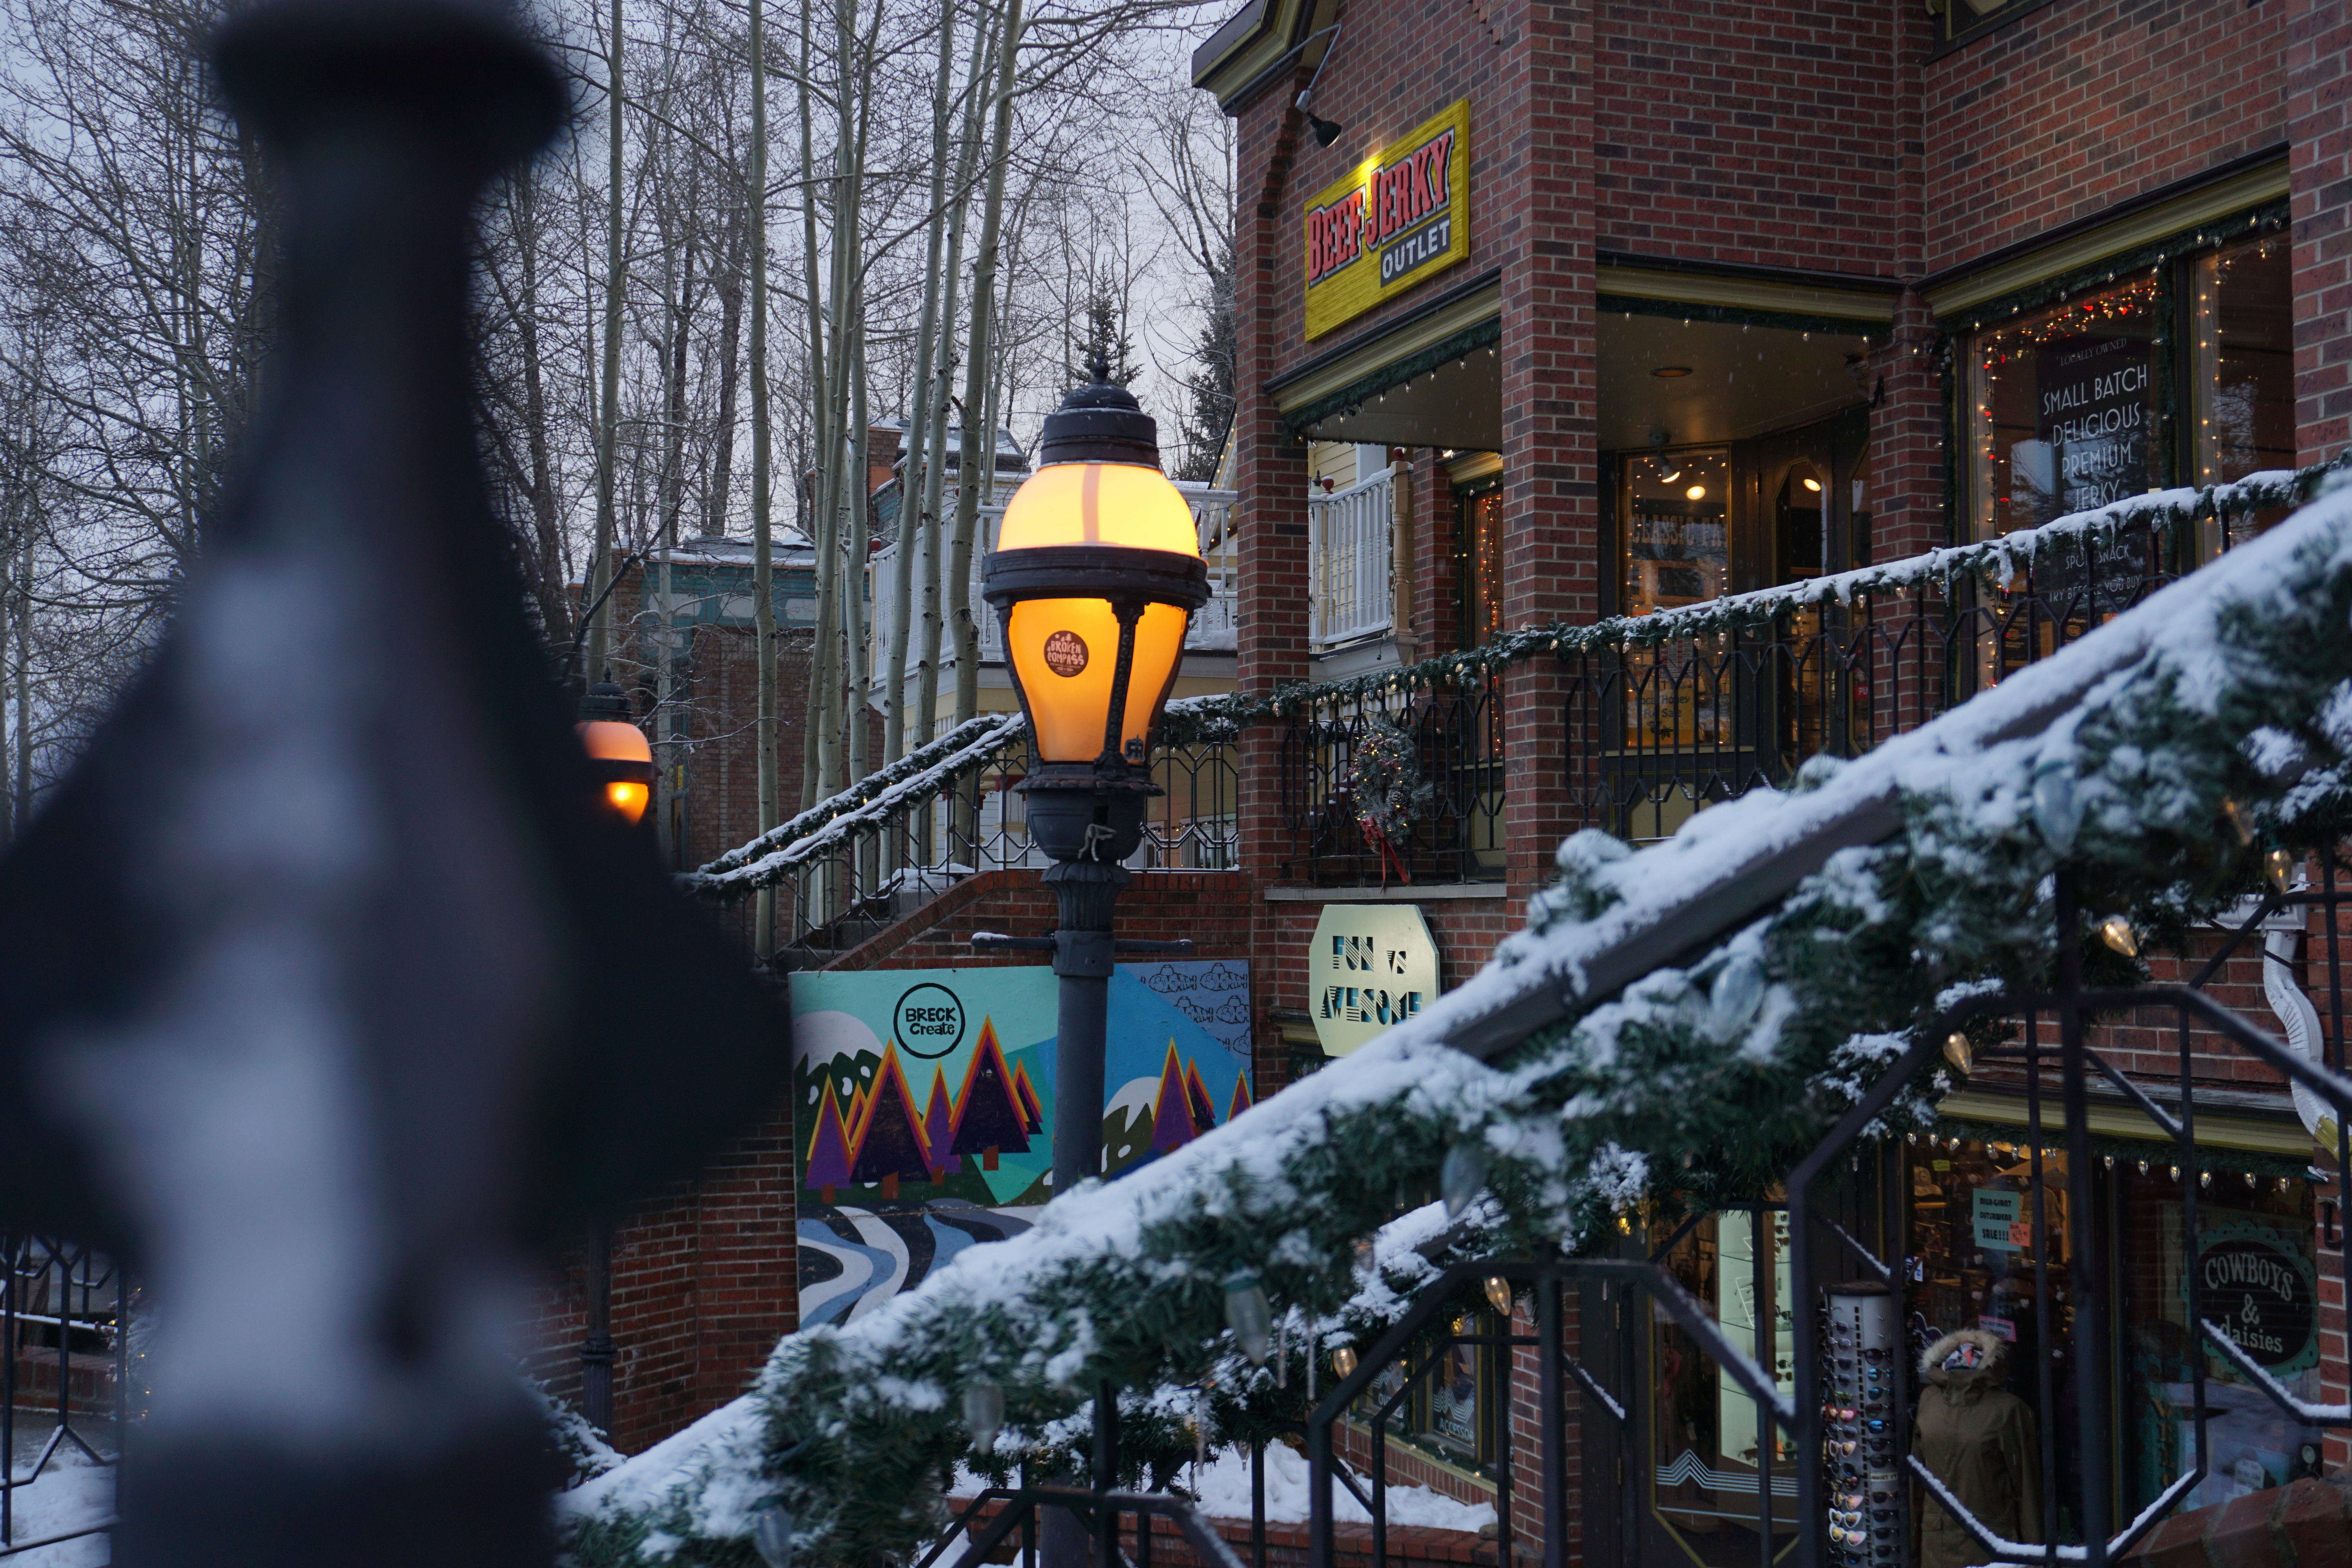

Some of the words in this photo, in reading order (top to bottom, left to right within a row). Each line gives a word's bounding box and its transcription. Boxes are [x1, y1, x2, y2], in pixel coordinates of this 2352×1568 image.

[1308, 188, 1366, 284] BEEF
[1365, 132, 1454, 247] JERKY
[1382, 219, 1450, 279] OUTLET
[2060, 347, 2093, 366] LOCALLY
[2096, 338, 2126, 354] OWNED
[2044, 382, 2088, 415] SMALL
[2095, 364, 2147, 400] BATCH
[2053, 402, 2140, 446] DELICIOUS
[2062, 441, 2131, 479] PREMIUM
[2074, 479, 2120, 512] JERKY
[1632, 514, 1694, 545] CLASSIC
[2098, 544, 2129, 563] SNACK
[2105, 579, 2123, 592] YOU
[1047, 652, 1085, 665] COMPASS
[1051, 641, 1081, 654] BROKEN
[1661, 695, 1690, 704] Hoey
[1662, 708, 1682, 717] Sae
[1333, 936, 1374, 972] FUN
[1387, 950, 1406, 974] IS
[906, 1007, 956, 1022] BRECK
[1320, 986, 1423, 1025] AWESOME
[909, 1022, 955, 1035] Create
[1980, 1198, 2011, 1207] MEGA-GIANT
[1980, 1212, 2012, 1221] OUTERWEAR
[1983, 1228, 2009, 1241] SALE!!!
[2205, 1252, 2294, 1301] COWBOYS
[2241, 1294, 2260, 1325] &
[2221, 1314, 2283, 1353] daisies
